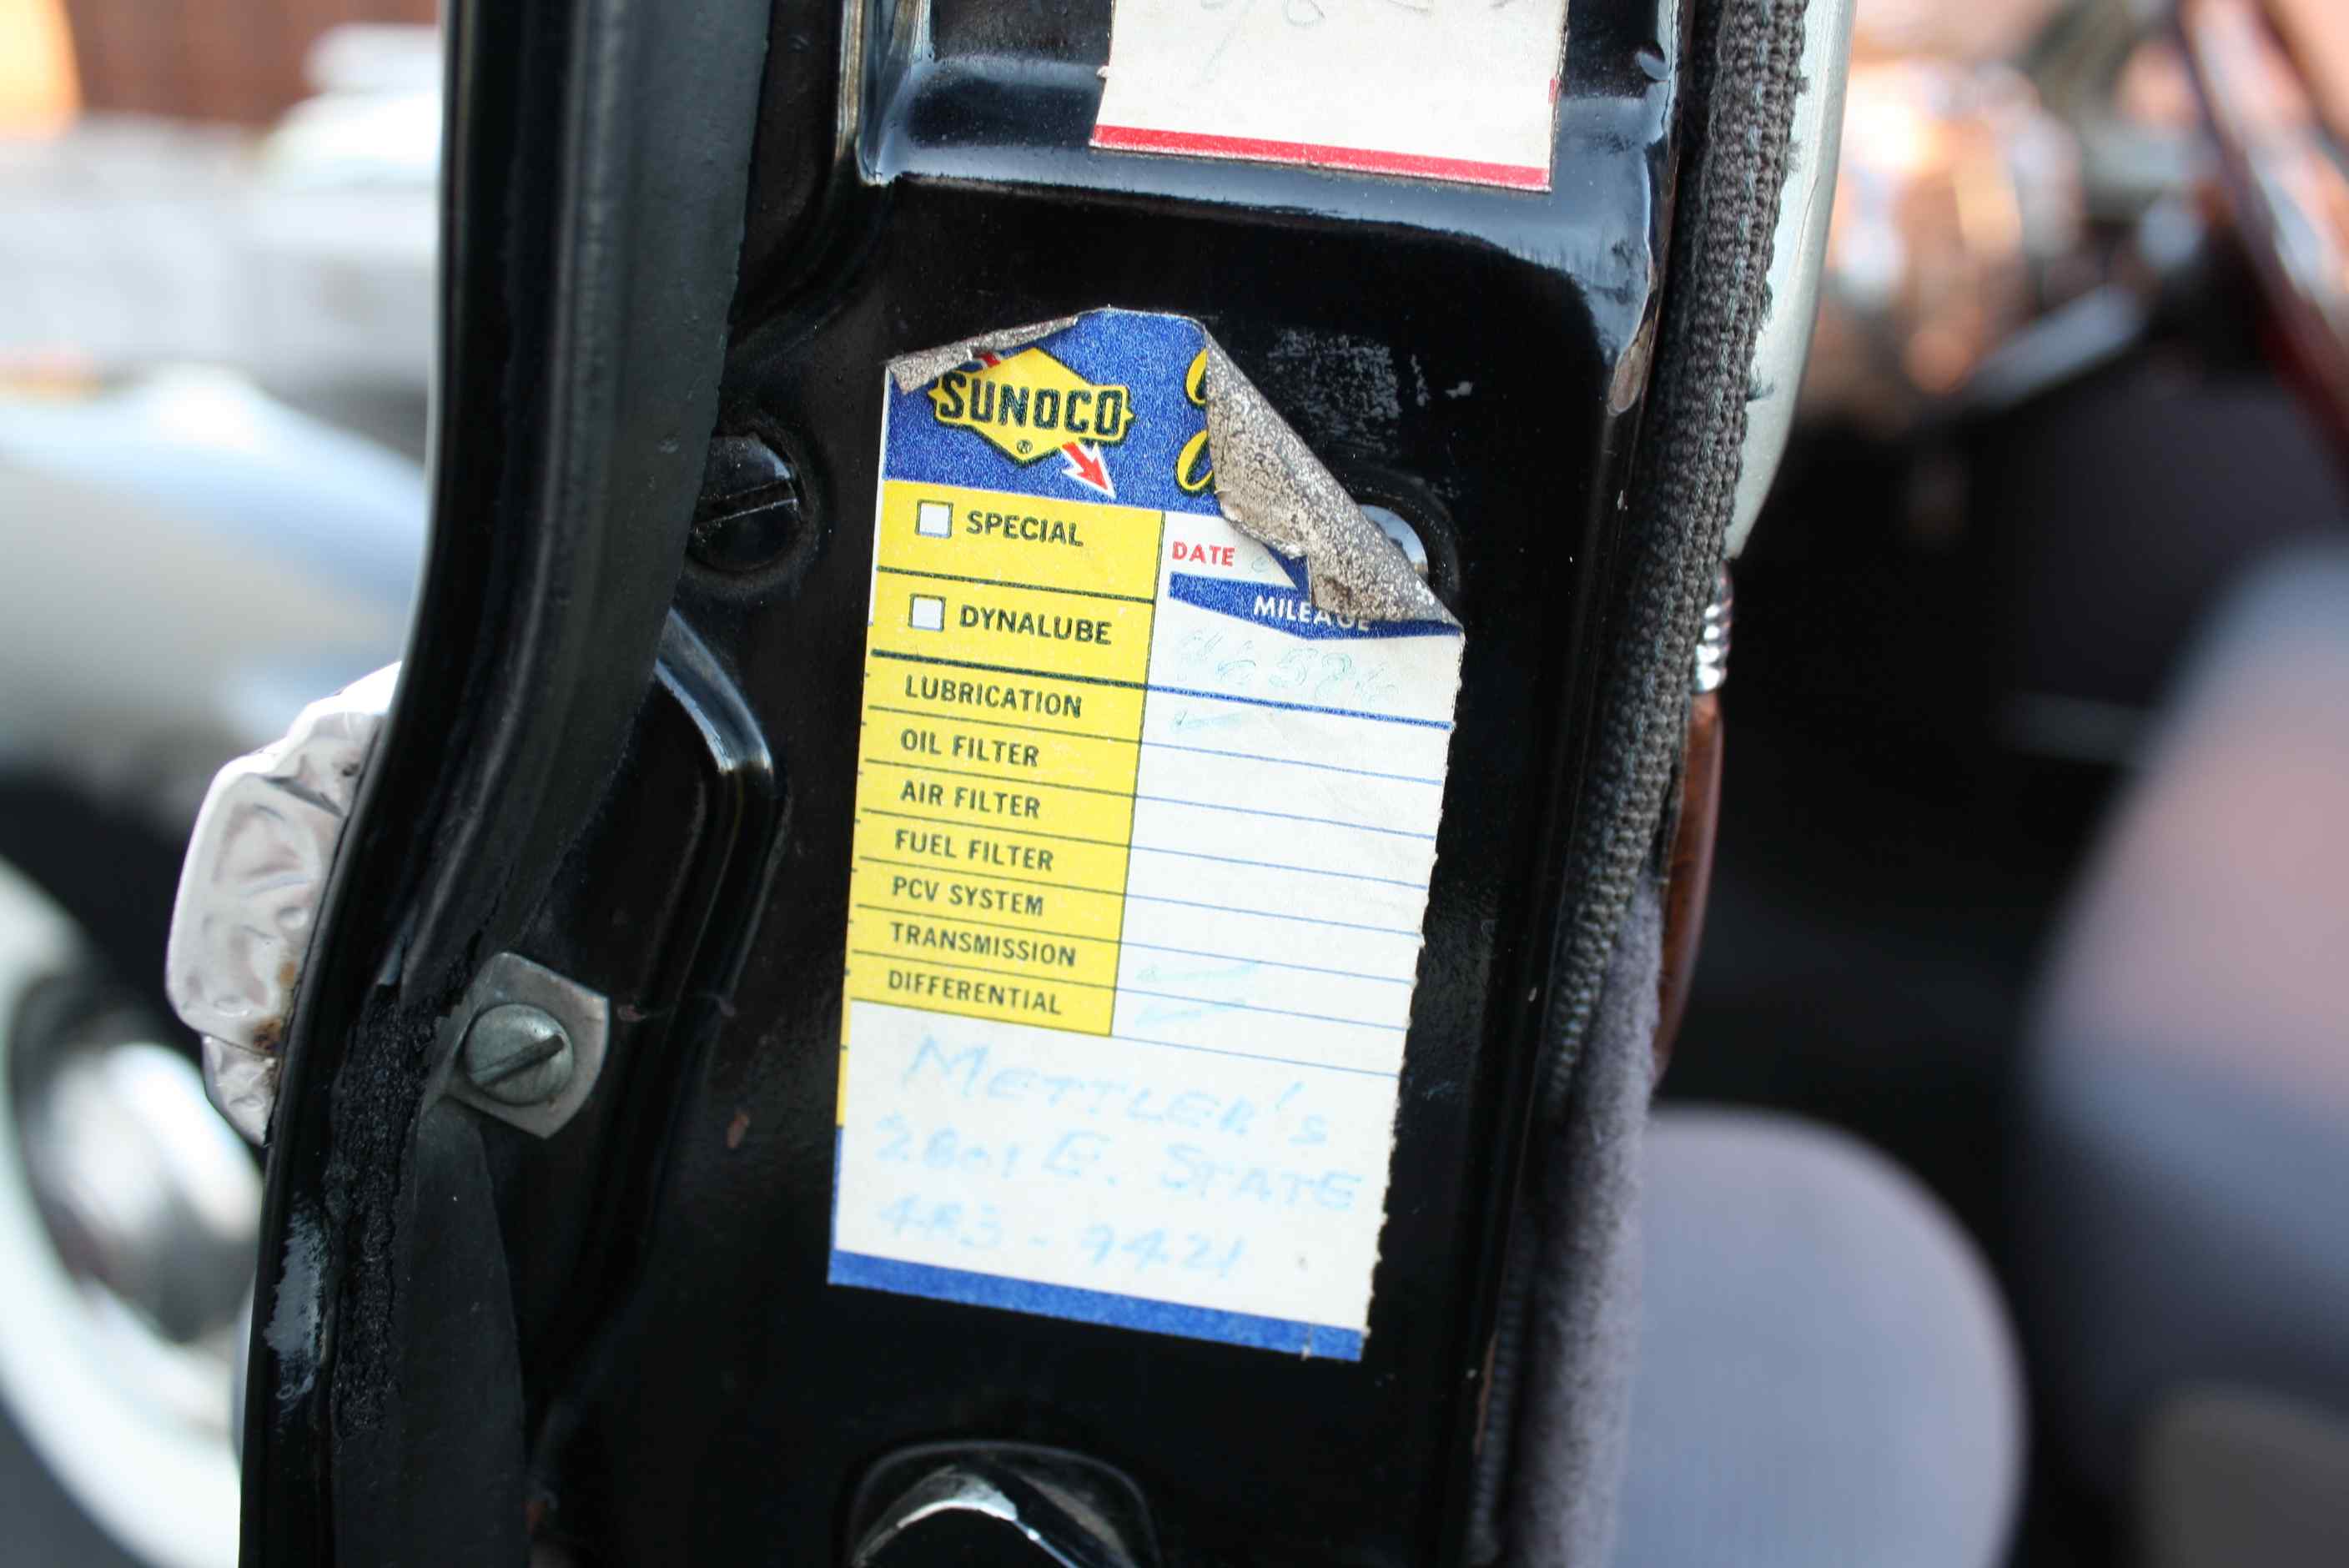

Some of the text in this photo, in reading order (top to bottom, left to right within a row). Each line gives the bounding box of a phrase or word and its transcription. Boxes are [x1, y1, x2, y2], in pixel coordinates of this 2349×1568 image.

[938, 371, 1123, 436] SUNOCO
[966, 511, 1084, 548] SPECIAL
[1172, 541, 1235, 566] DATE
[958, 605, 1113, 646] DYNALUBE
[905, 675, 1083, 718] LUBRICATION
[901, 728, 1039, 767] OIL FILTER
[899, 780, 1041, 819] AIR FILTER
[895, 829, 1054, 872] FUEL FILTER
[892, 876, 1044, 917] PCV SYSTEM
[890, 922, 1077, 967] TRANSMISSION
[888, 970, 1062, 1015] DIFFERENTIAL
